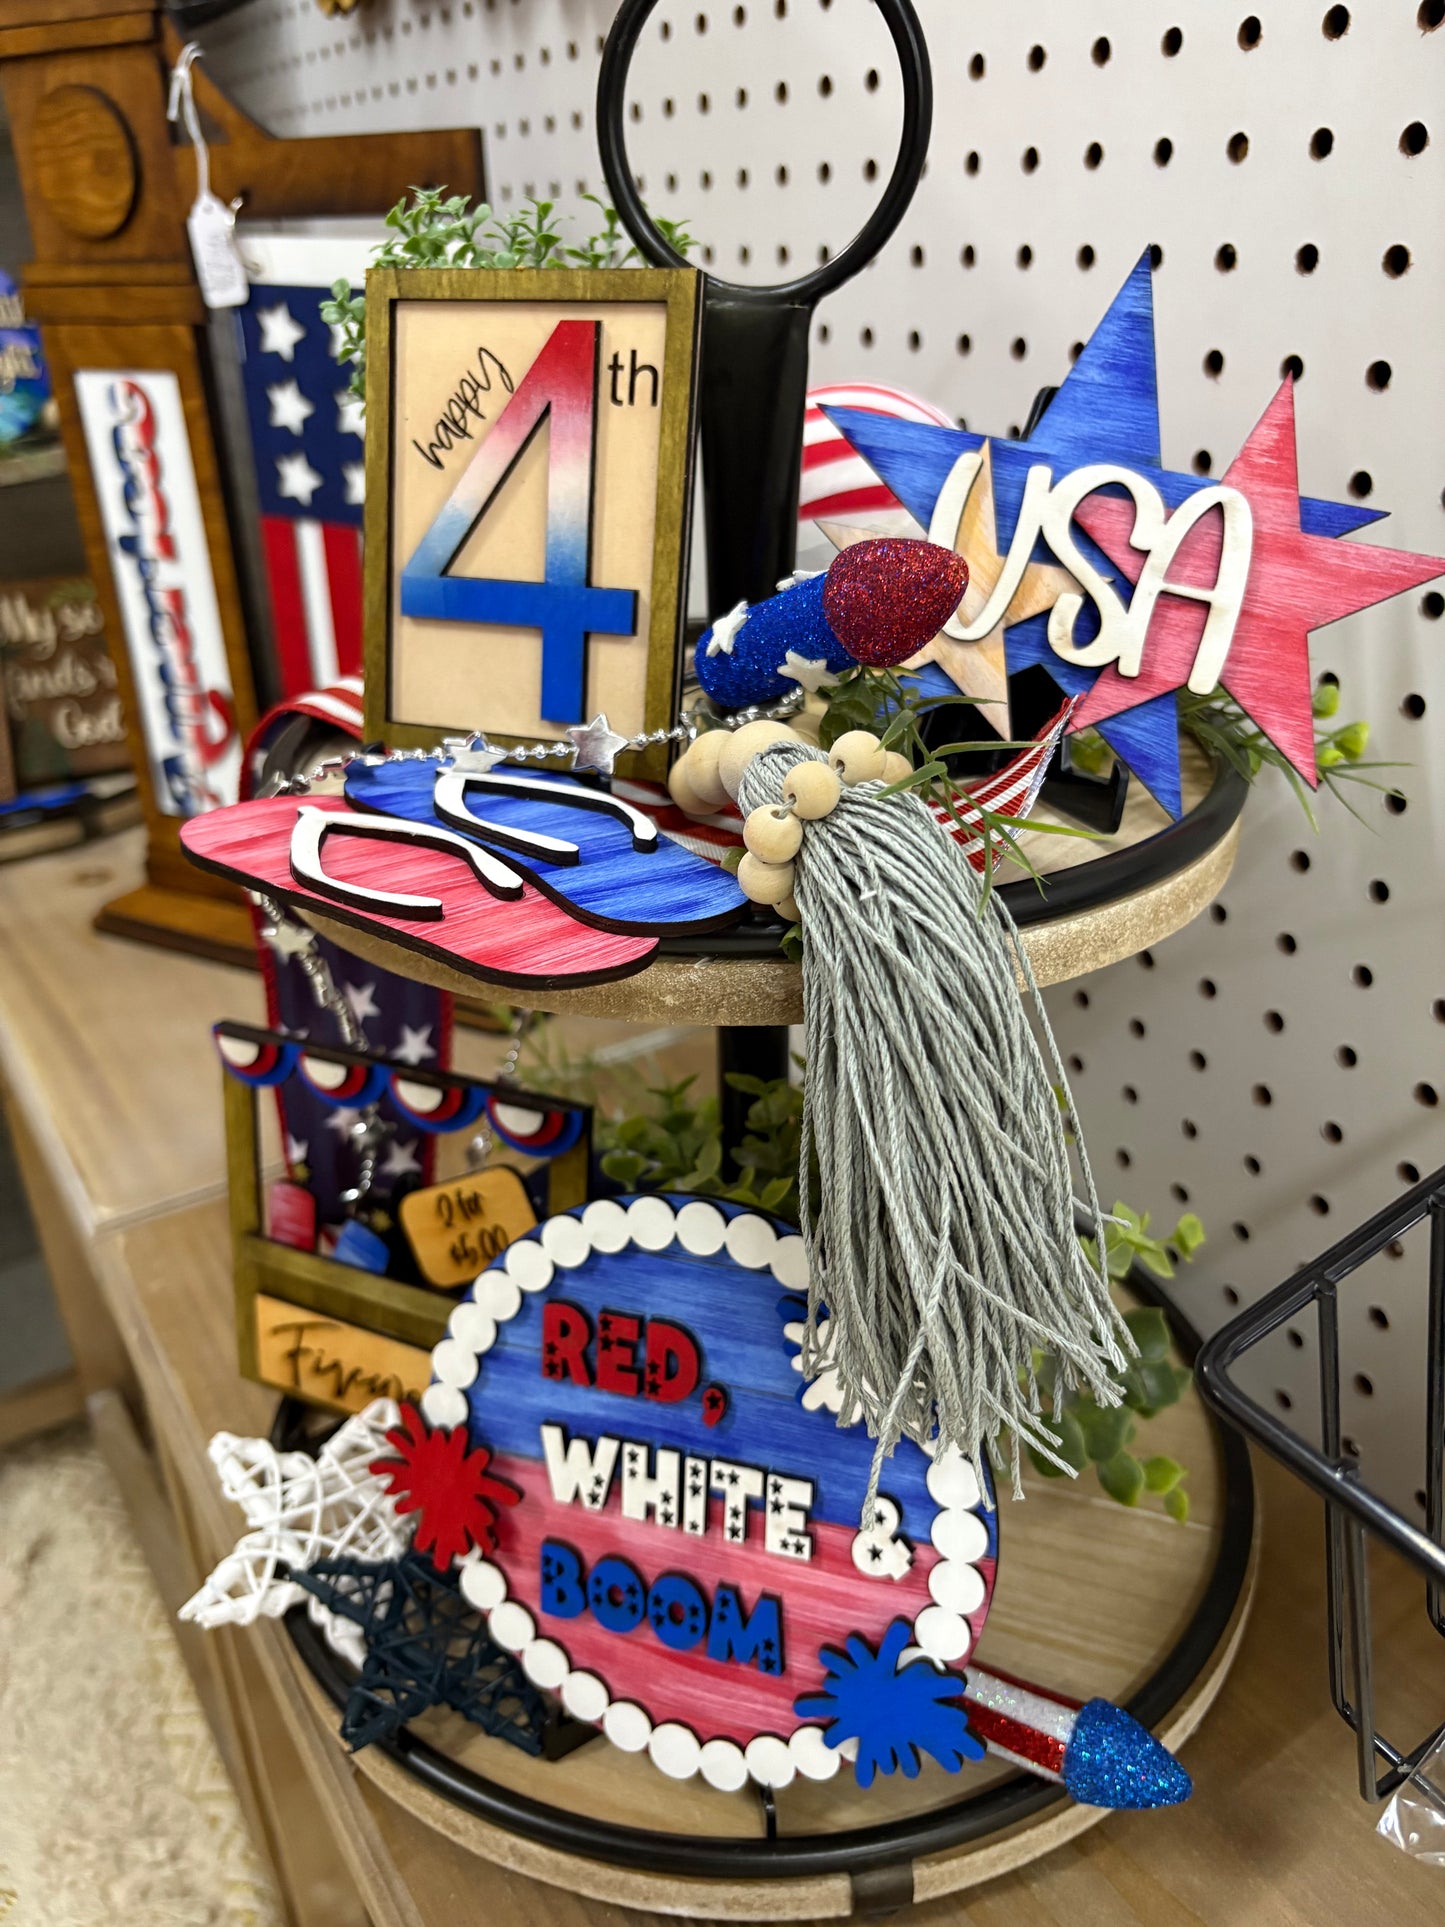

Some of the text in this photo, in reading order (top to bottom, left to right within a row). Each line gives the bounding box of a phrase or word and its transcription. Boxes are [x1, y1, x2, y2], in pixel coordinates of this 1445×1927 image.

[413, 347, 514, 470] happy
[926, 452, 1252, 695] USA
[541, 1301, 729, 1428] RED,
[540, 1420, 916, 1582] WHITE &
[540, 1537, 785, 1677] BOOM
